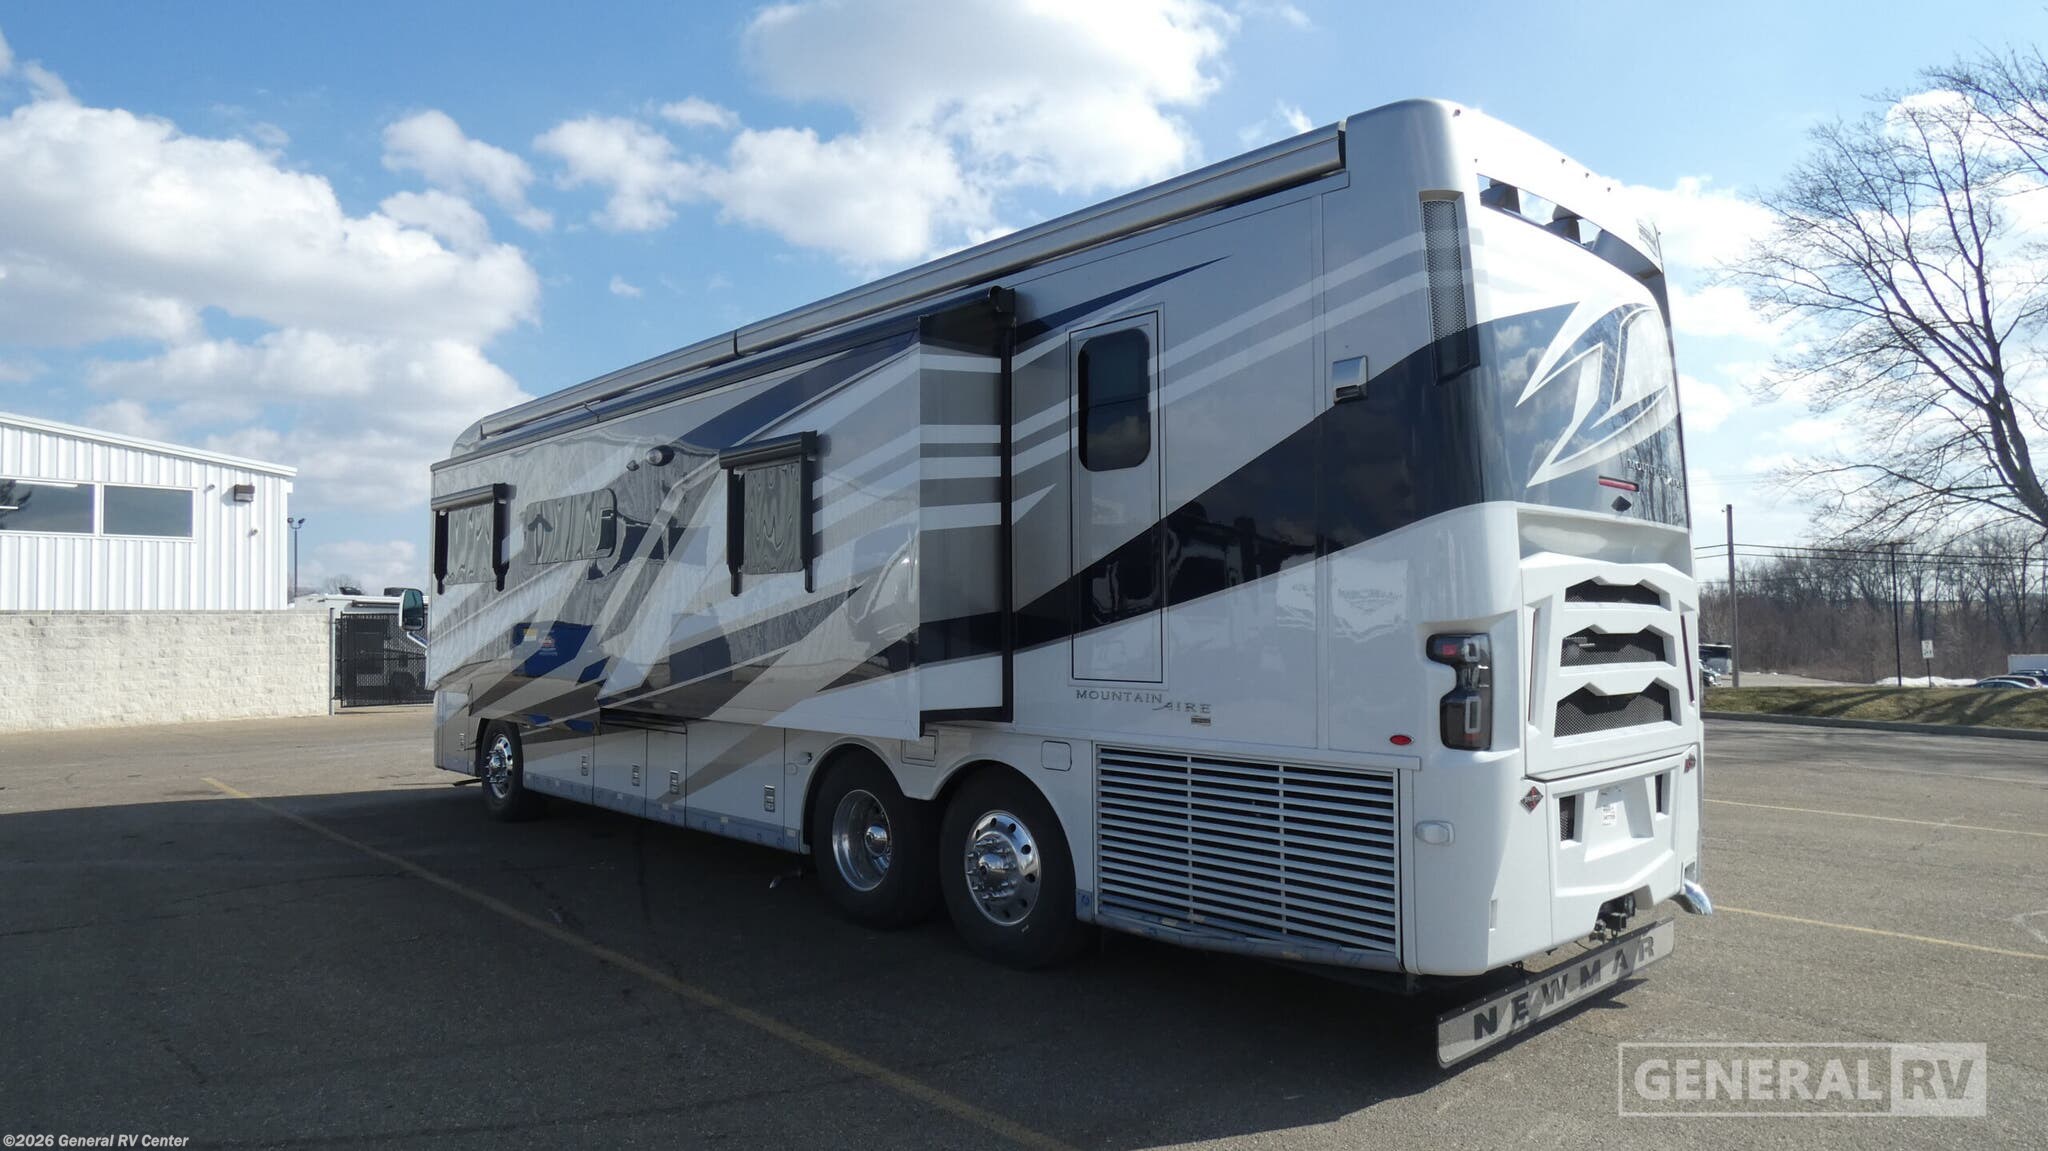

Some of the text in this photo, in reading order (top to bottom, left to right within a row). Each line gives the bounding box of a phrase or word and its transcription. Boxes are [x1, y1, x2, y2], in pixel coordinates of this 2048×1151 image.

[1076, 689, 1212, 714] MOUNTAIN AIRE
[1473, 935, 1655, 1041] NEWMAR
